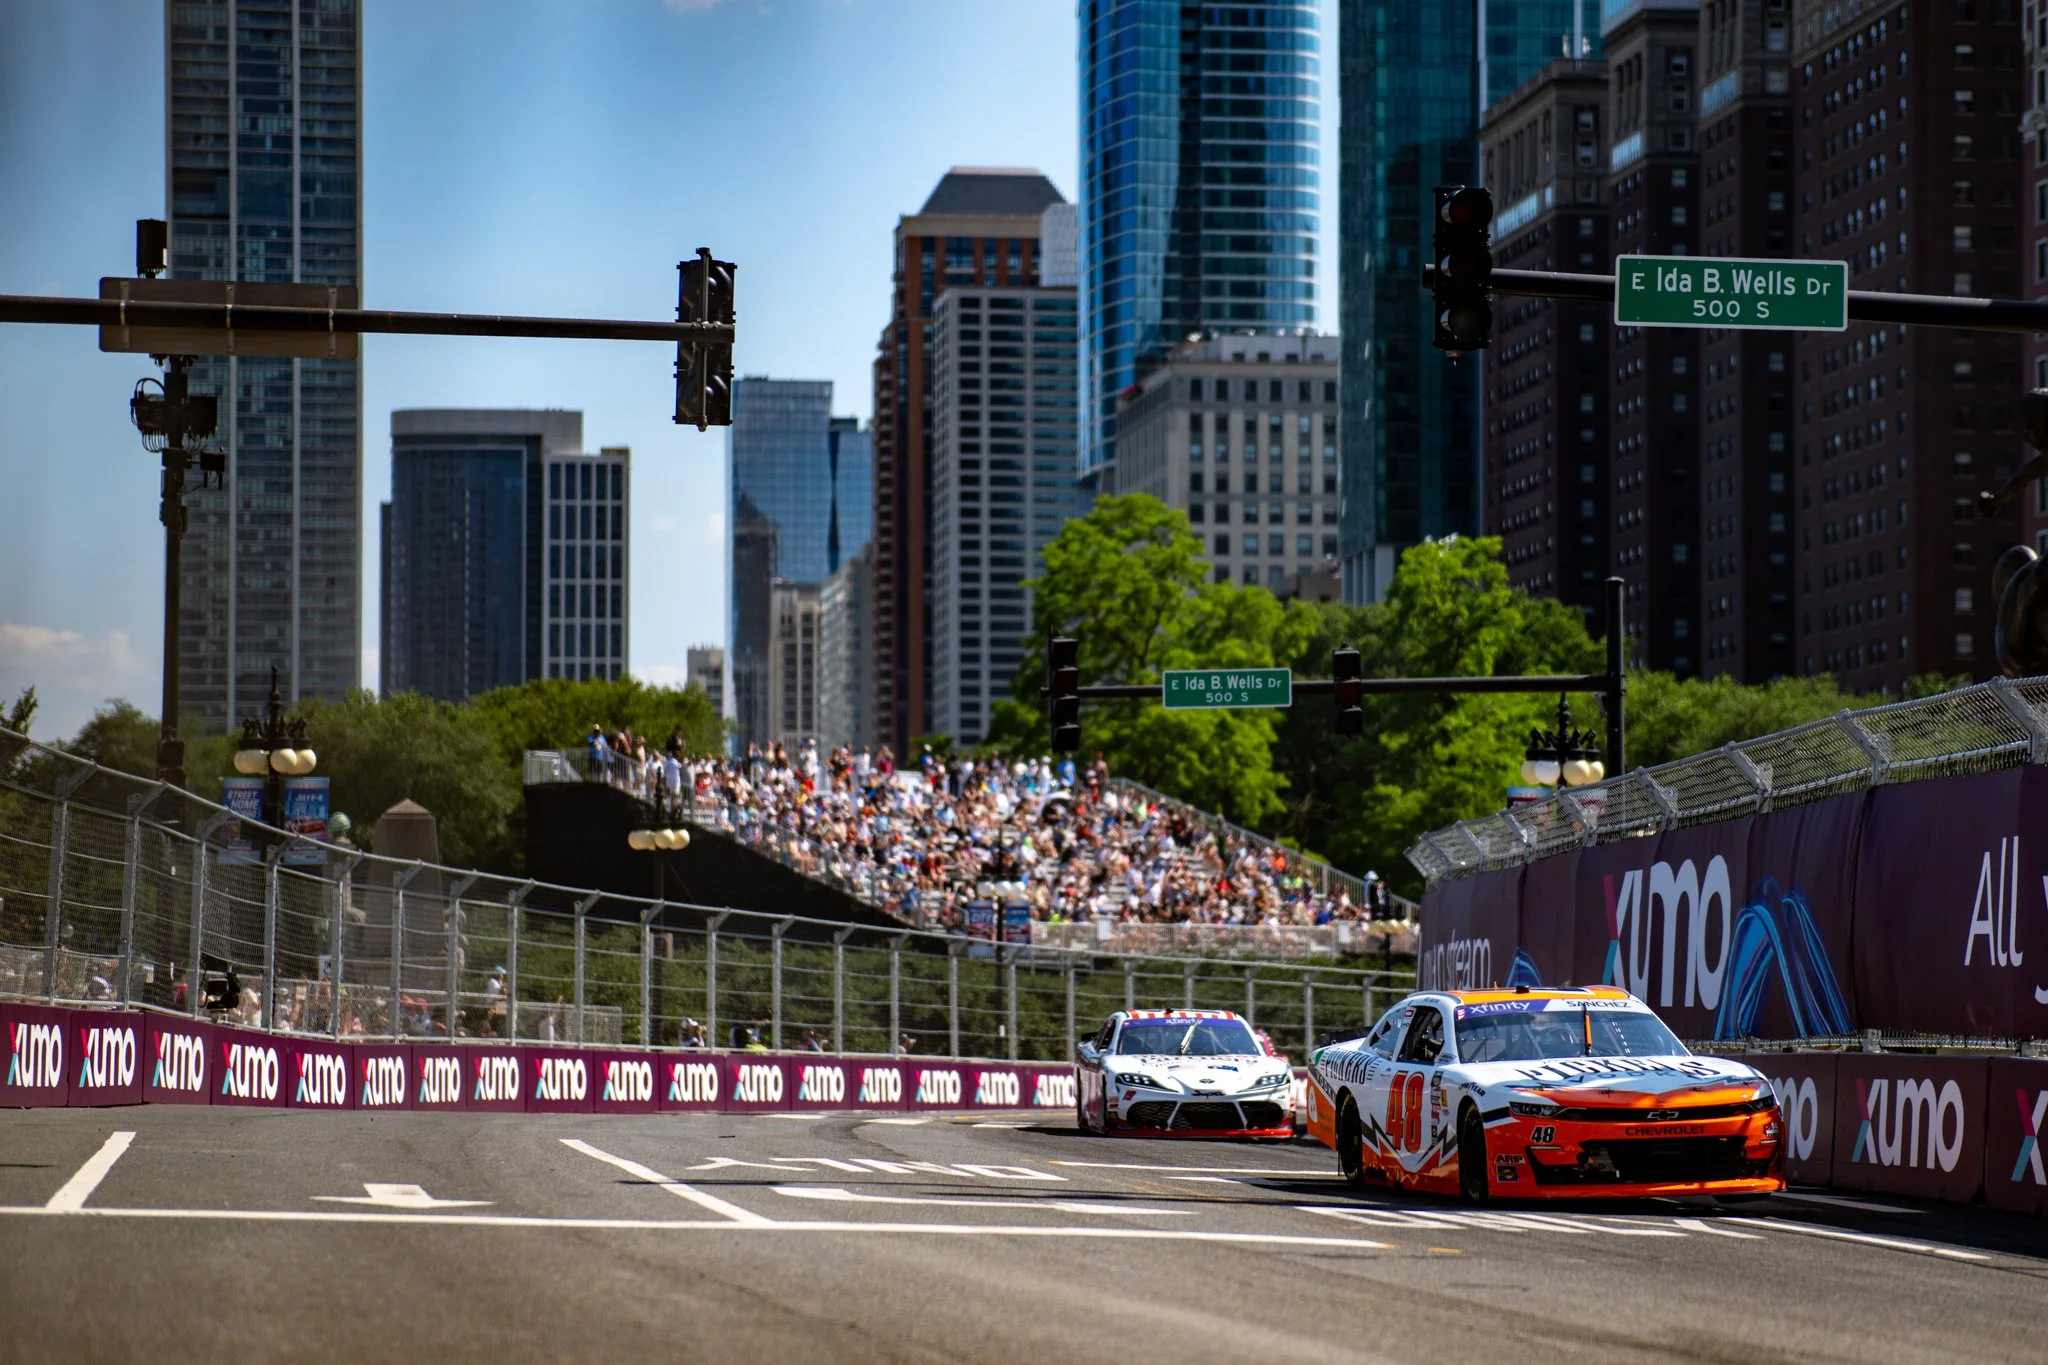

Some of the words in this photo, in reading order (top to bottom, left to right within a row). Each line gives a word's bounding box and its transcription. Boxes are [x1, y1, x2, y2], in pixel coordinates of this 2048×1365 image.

[1632, 273, 1645, 290] E
[1657, 267, 1692, 293] Ida
[1703, 268, 1725, 294] B.
[1732, 269, 1796, 296] Wells
[1806, 278, 1831, 296] Dr
[1693, 300, 1741, 318] 500
[1756, 301, 1770, 319] S
[1171, 680, 1179, 690] E
[1185, 676, 1205, 690] Ida
[1211, 675, 1223, 690] B.
[1227, 675, 1262, 689] Wells
[1268, 678, 1282, 688] Dr
[1206, 692, 1232, 703] 500
[1241, 692, 1249, 702] S
[1964, 836, 2024, 967] All
[1470, 1002, 1530, 1014] xfinity
[1566, 1000, 1632, 1009] SANCHEZ
[1386, 1070, 1425, 1154] 48
[1531, 1125, 1556, 1144] 48
[1625, 1125, 1704, 1136] CHEVROLET
